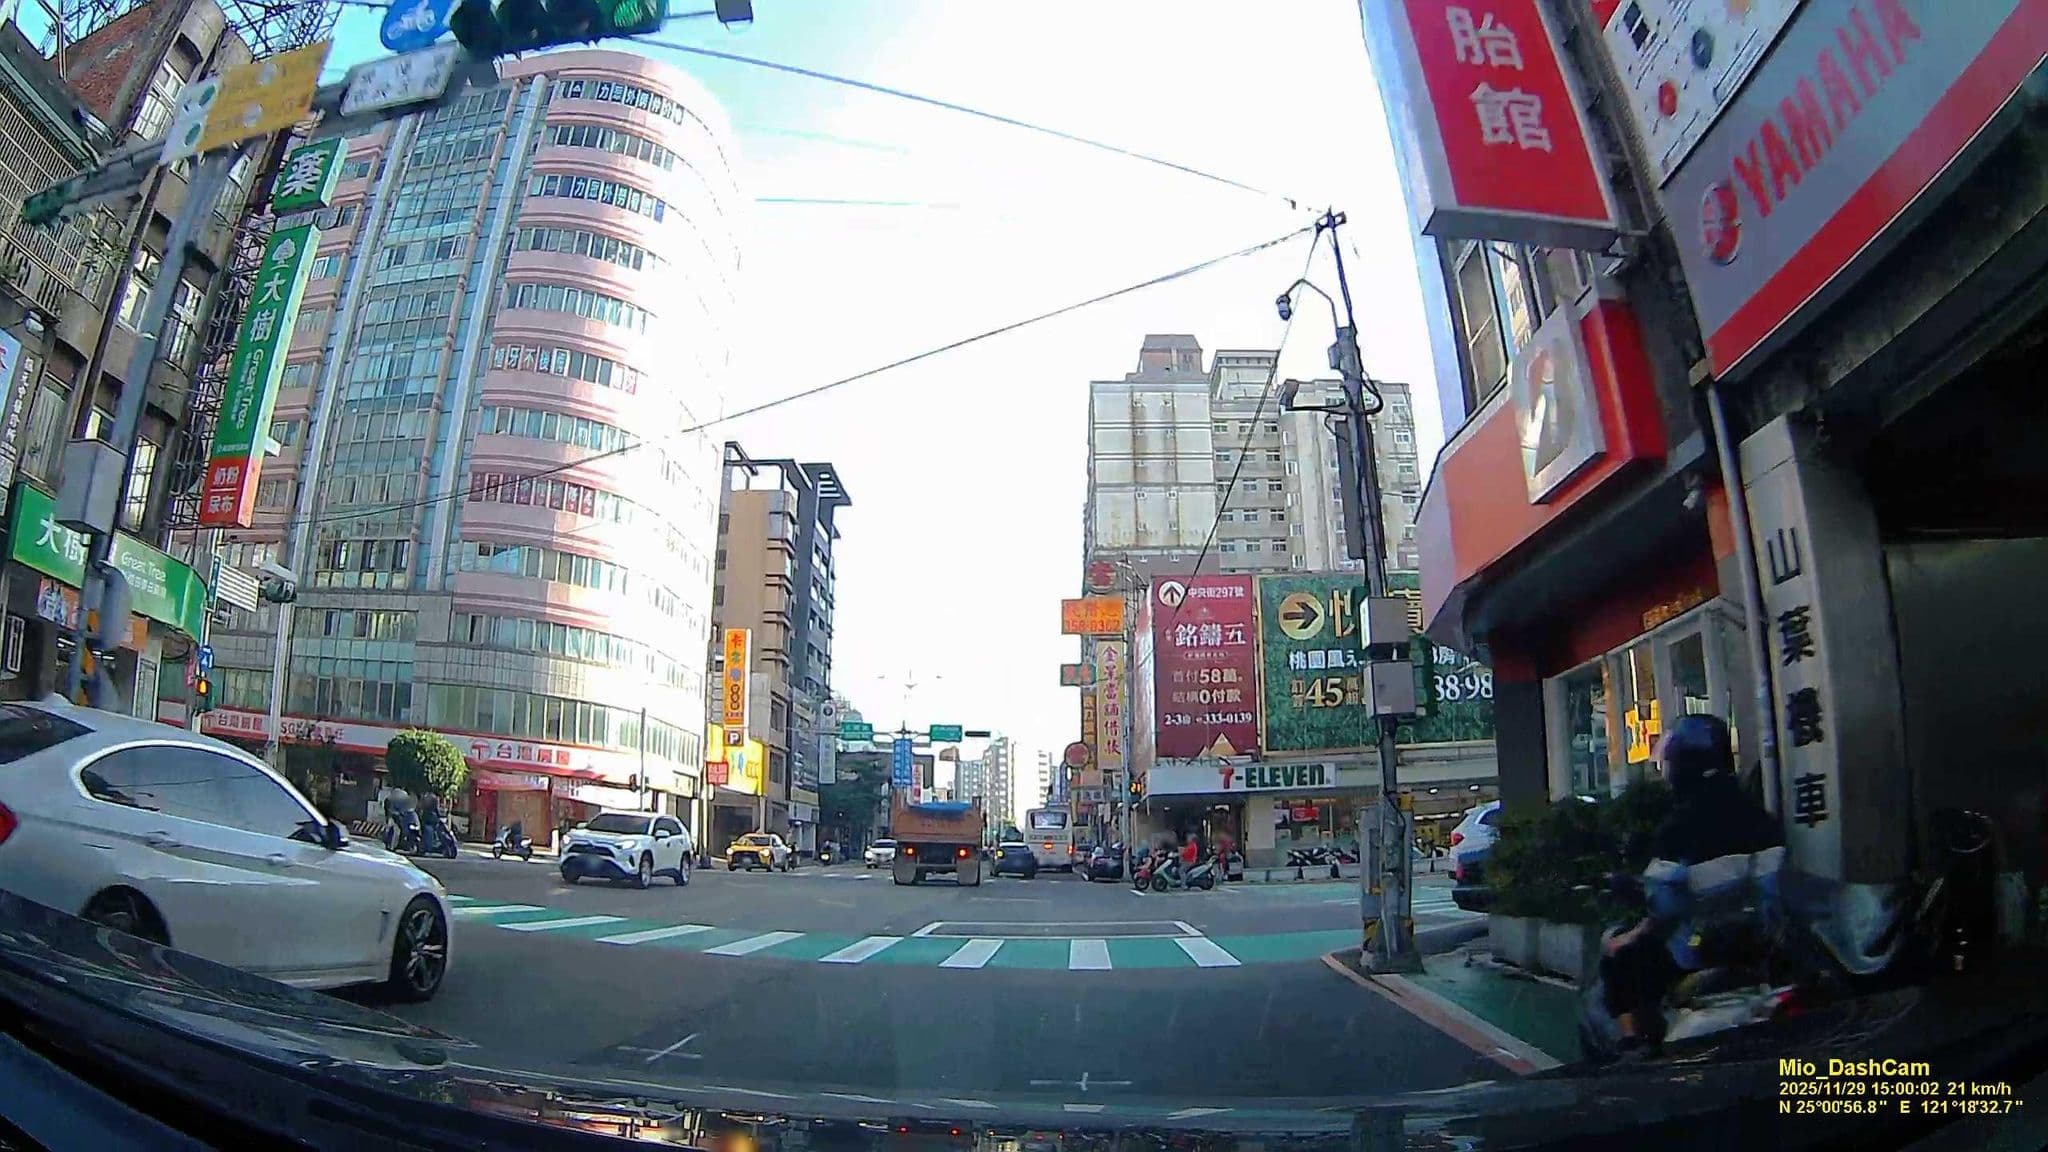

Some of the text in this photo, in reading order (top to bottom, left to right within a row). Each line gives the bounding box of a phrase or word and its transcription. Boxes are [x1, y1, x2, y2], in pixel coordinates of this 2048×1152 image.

[1446, 5, 1552, 153] 胎館
[1733, 0, 1921, 217] YAMAHA
[250, 273, 286, 342] 大樹
